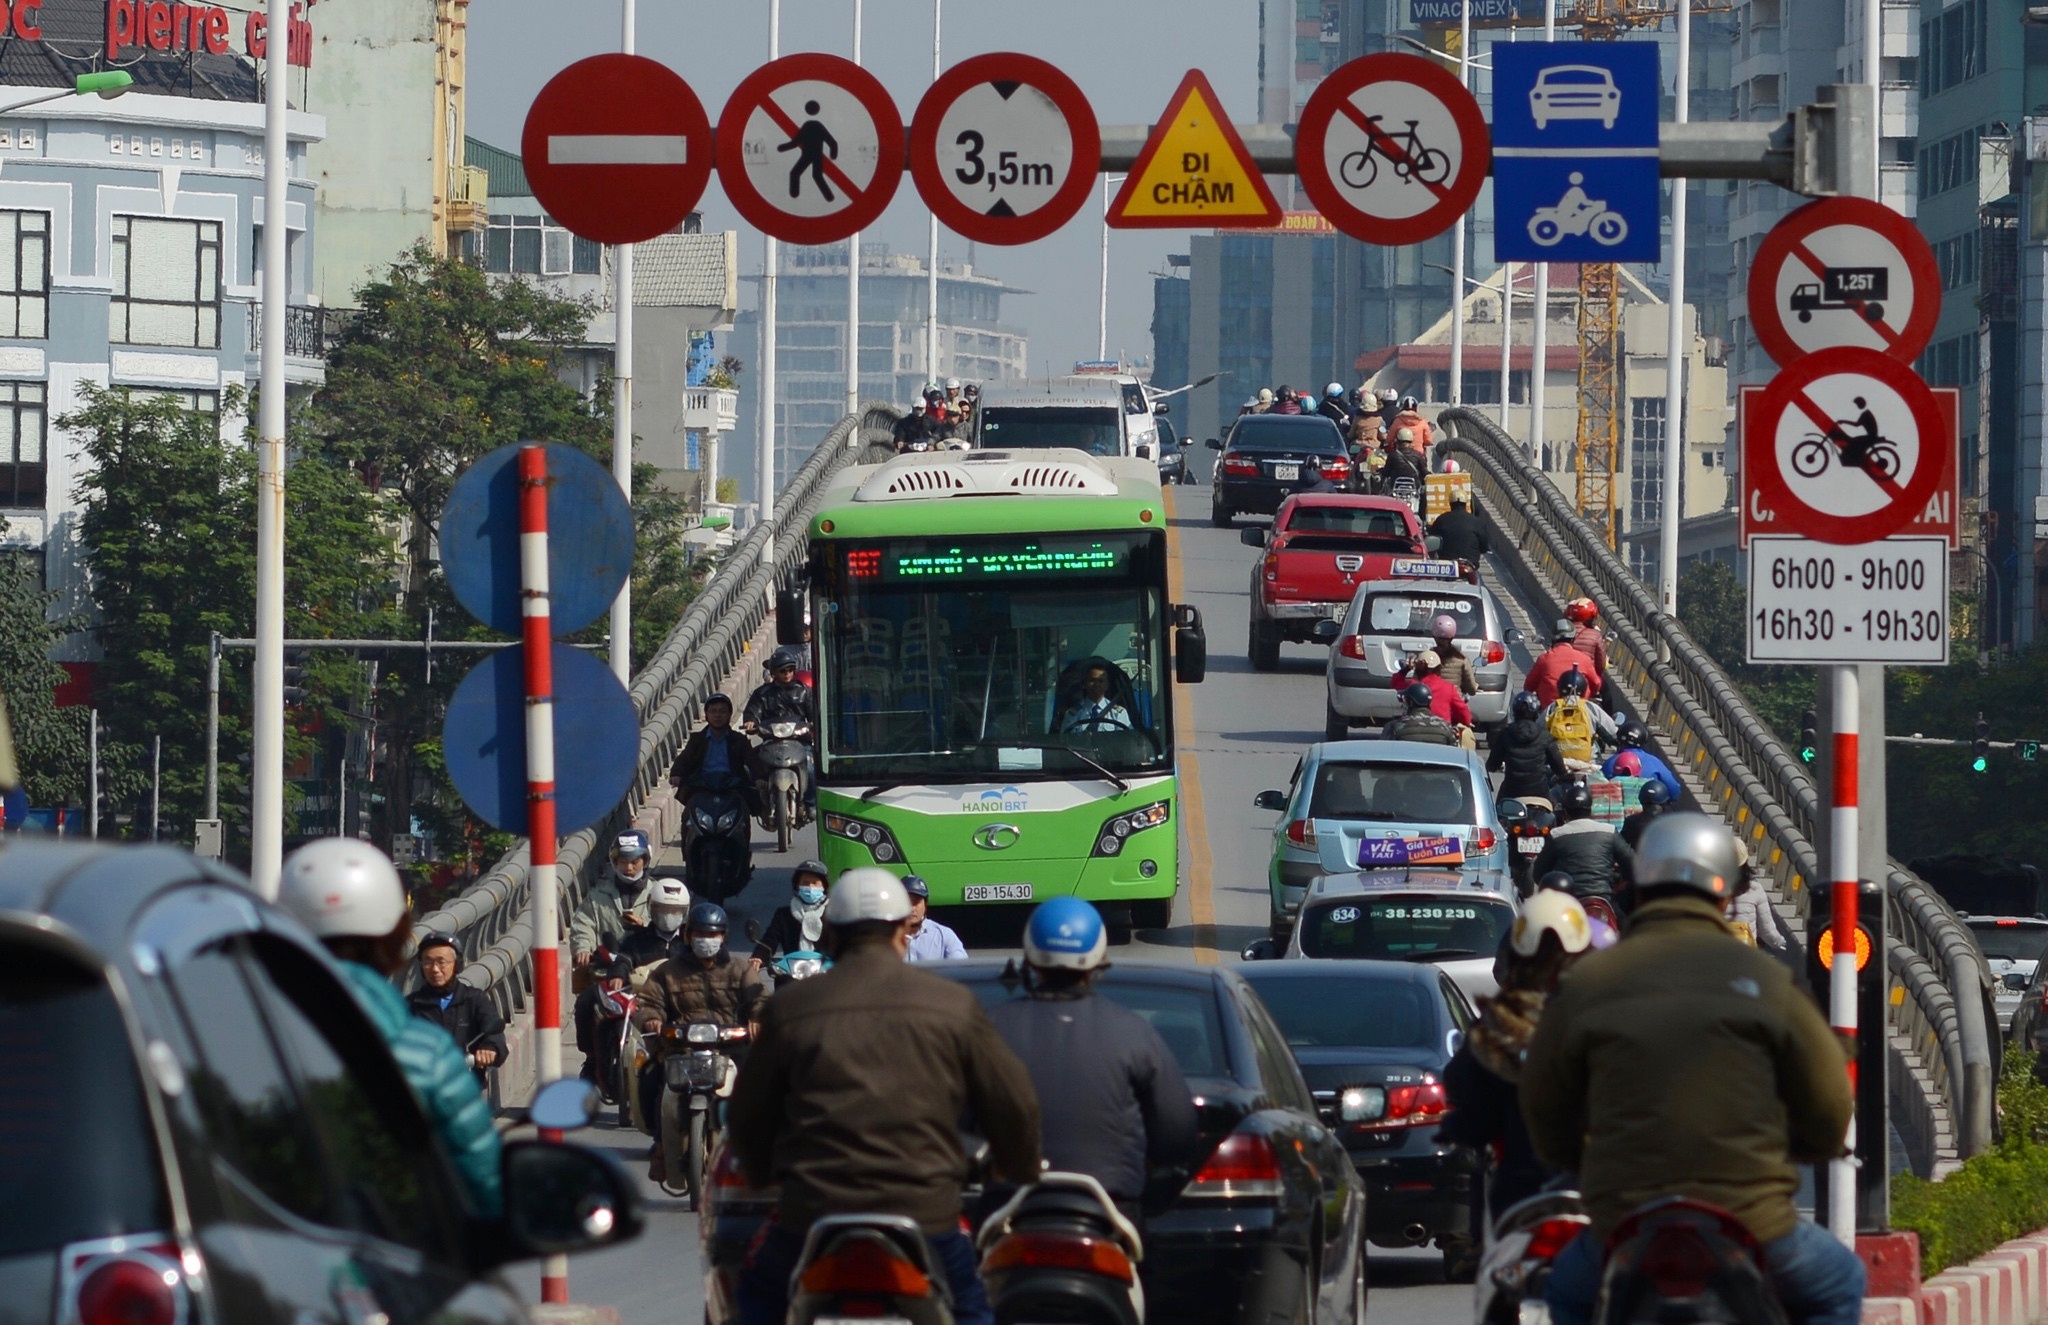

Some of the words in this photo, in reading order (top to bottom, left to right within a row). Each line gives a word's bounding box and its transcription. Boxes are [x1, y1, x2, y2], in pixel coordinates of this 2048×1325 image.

[106, 0, 230, 59] pierre
[955, 129, 1054, 193] 3,5m
[1181, 152, 1209, 173] ĐI
[1152, 177, 1234, 209] CHẬM
[1837, 274, 1875, 291] 1,25T
[1772, 557, 1835, 589] 6h00
[1862, 558, 1925, 590] 9h00
[1756, 608, 1834, 641] 16h30
[1862, 609, 1941, 642] 19h30
[1371, 851, 1394, 859] TAXI
[1333, 907, 1355, 921] 634
